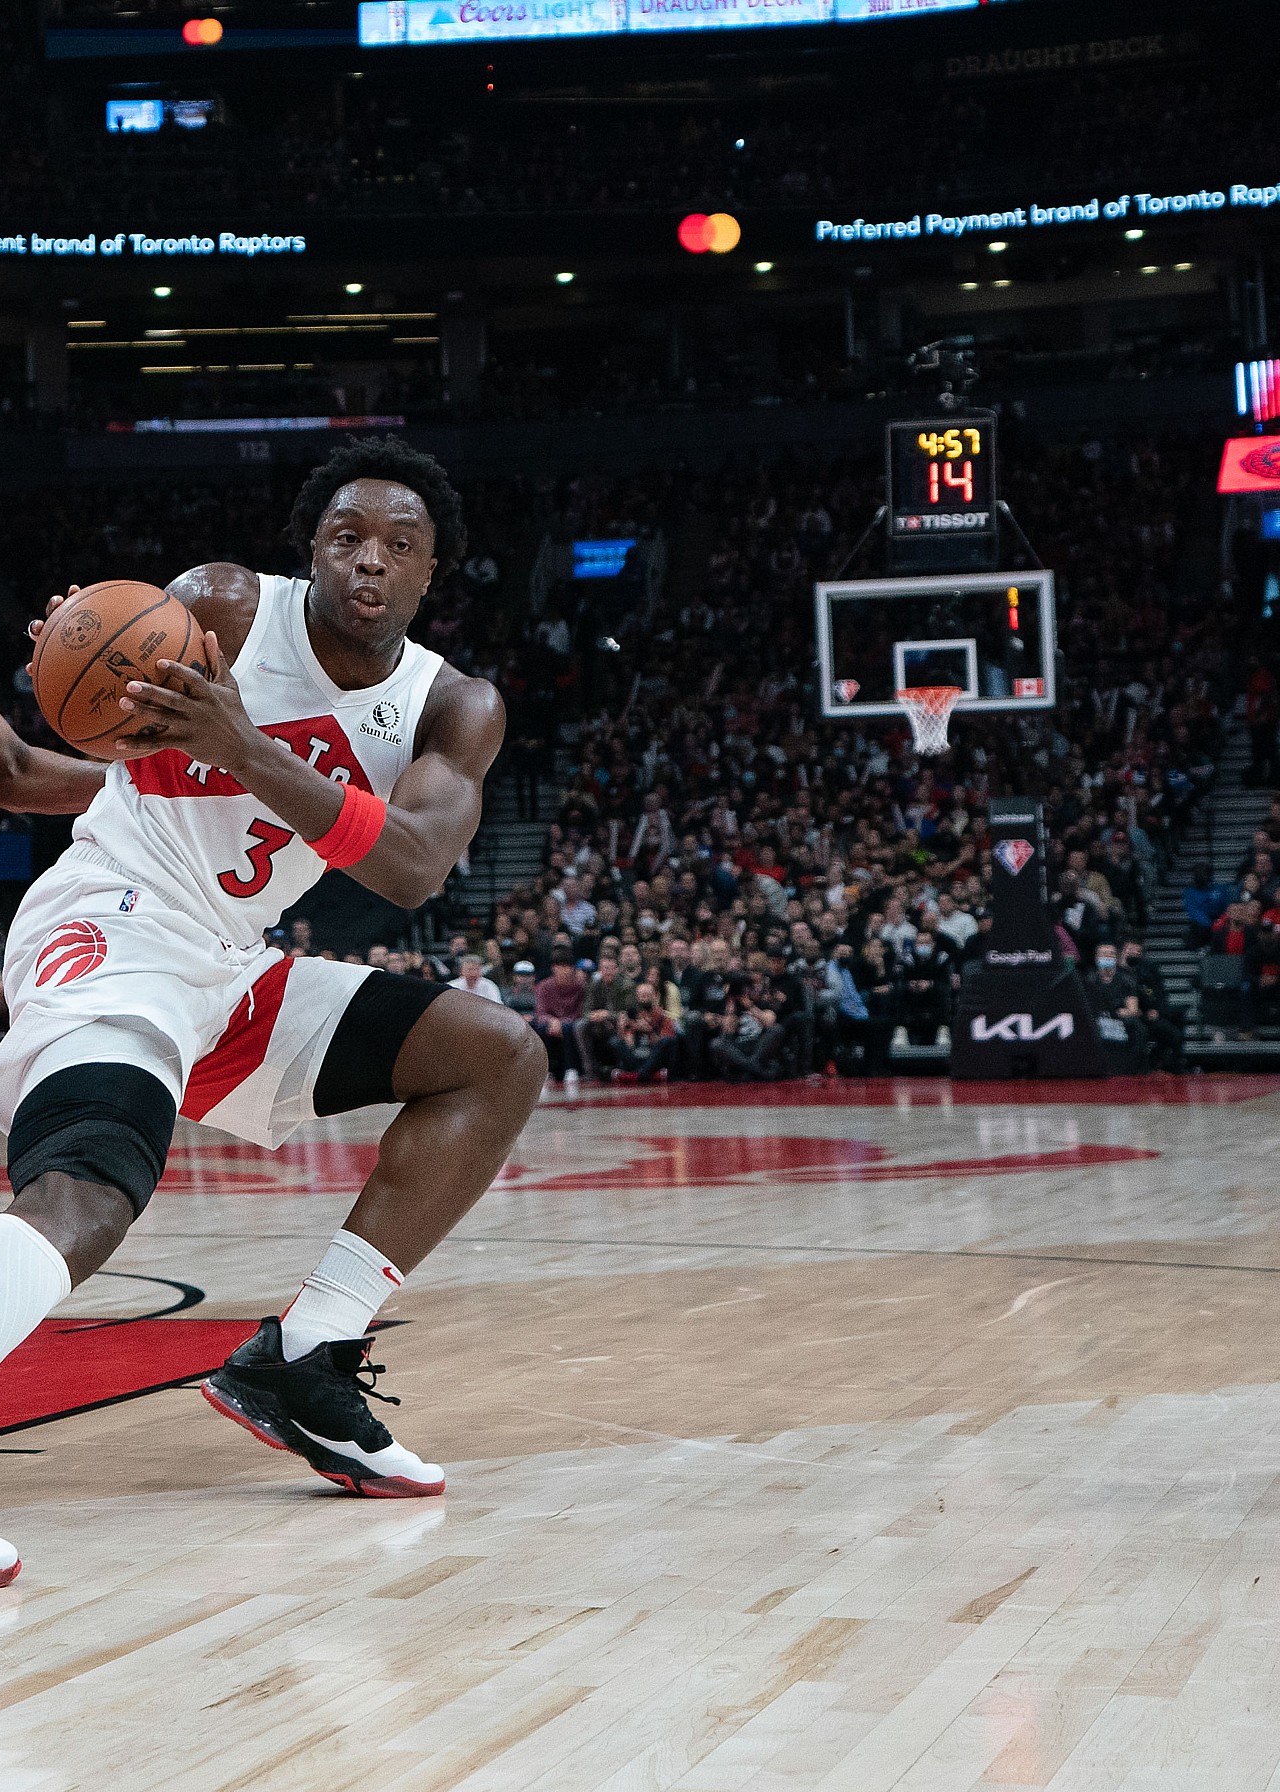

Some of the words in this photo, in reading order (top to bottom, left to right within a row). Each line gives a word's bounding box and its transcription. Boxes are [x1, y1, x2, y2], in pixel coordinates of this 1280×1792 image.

[460, 0, 526, 23] Coors
[532, 2, 596, 20] LIGHT
[945, 44, 1081, 77] DRAUGHT
[1087, 34, 1164, 62] DECK
[815, 214, 922, 241] Preferred
[924, 207, 1028, 237] Payment
[1029, 198, 1100, 226] brand
[1102, 195, 1131, 217] of
[1132, 189, 1226, 215] Toronto
[30, 232, 96, 256] brand
[100, 233, 127, 256] of
[128, 233, 215, 256] Toronto
[218, 232, 306, 257] Raptors
[918, 428, 981, 458] 4:57
[929, 460, 973, 504] 14
[921, 512, 990, 529] TISSOT
[359, 722, 381, 738] Sun
[382, 730, 402, 746] Life
[216, 817, 296, 899] 3
[987, 949, 1026, 965] Google
